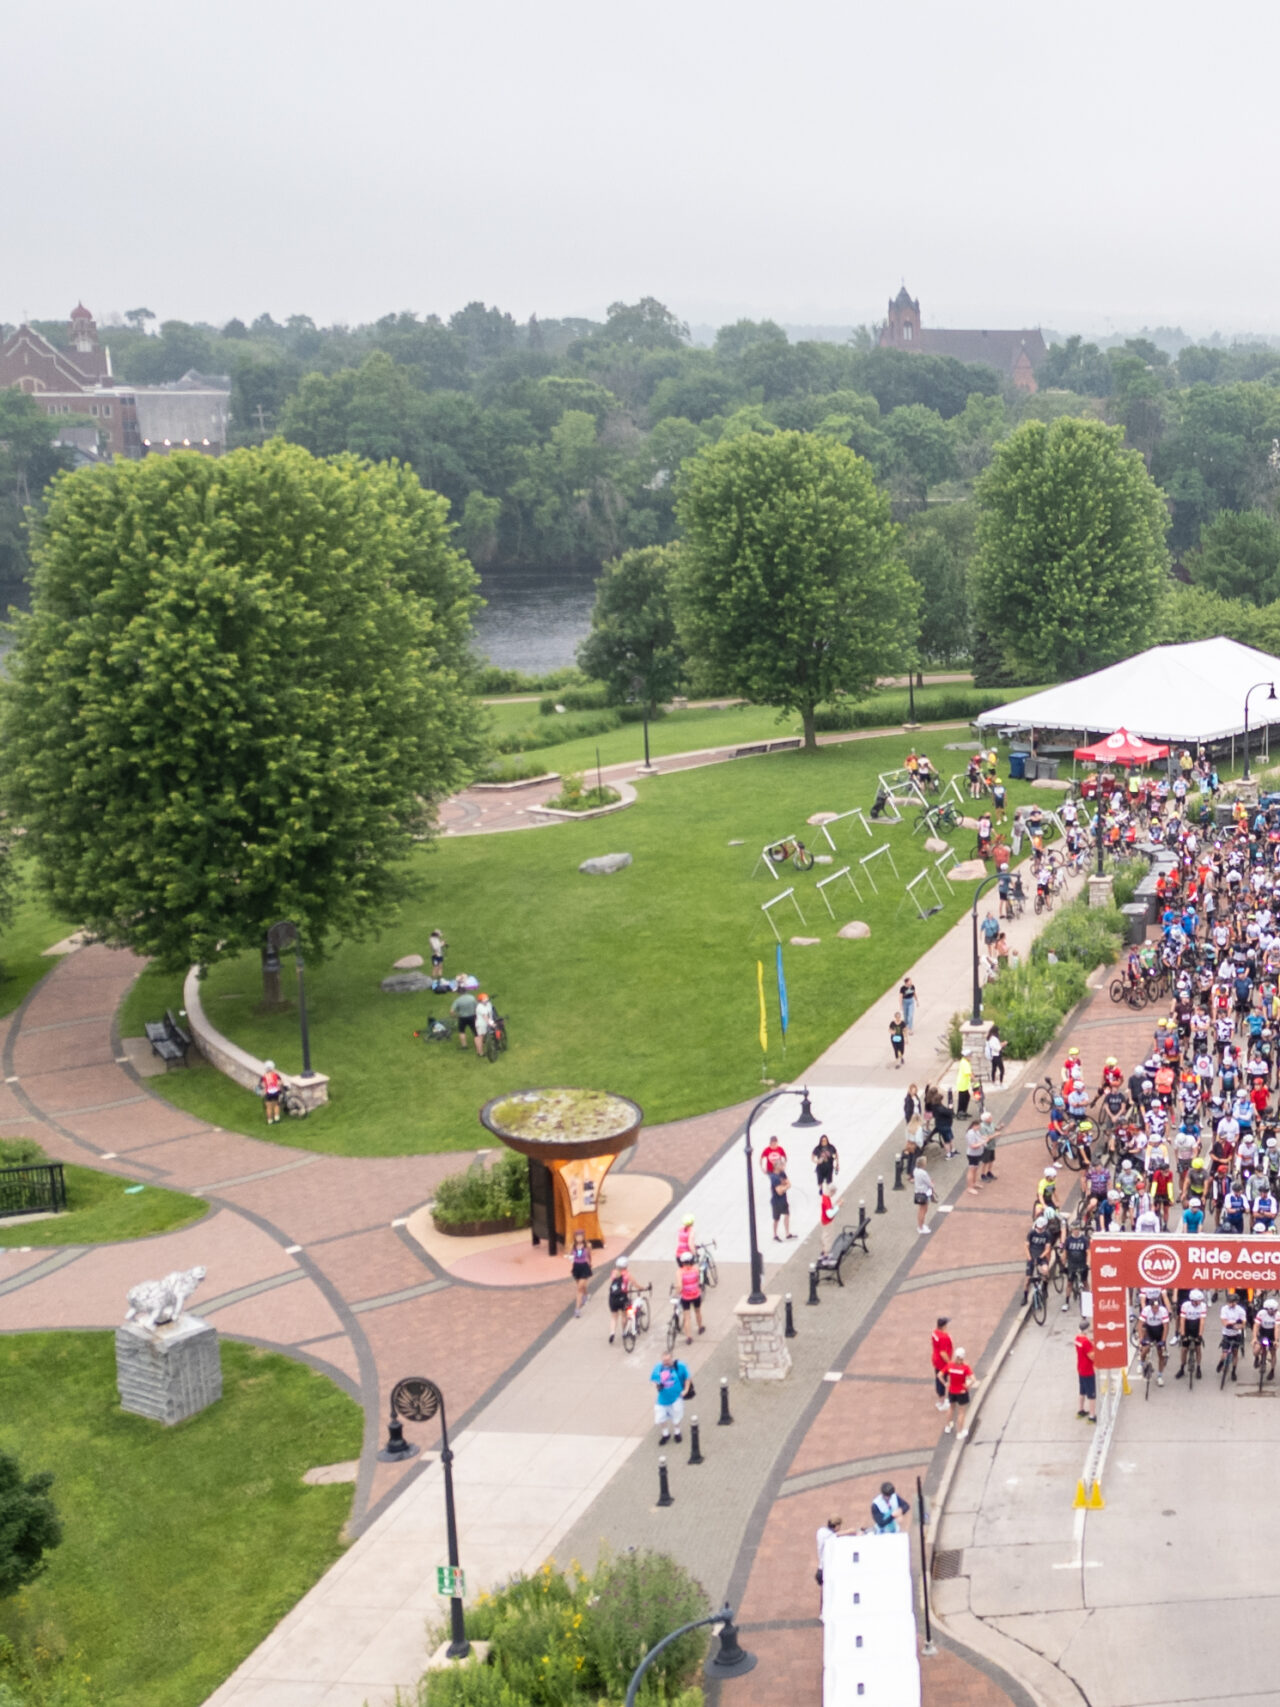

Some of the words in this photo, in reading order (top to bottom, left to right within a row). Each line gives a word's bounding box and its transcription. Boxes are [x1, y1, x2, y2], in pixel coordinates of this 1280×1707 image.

[1188, 1247, 1232, 1264] Ride
[1143, 1259, 1175, 1271] RAW
[1192, 1268, 1209, 1280] All
[1212, 1268, 1277, 1281] Proceeds
